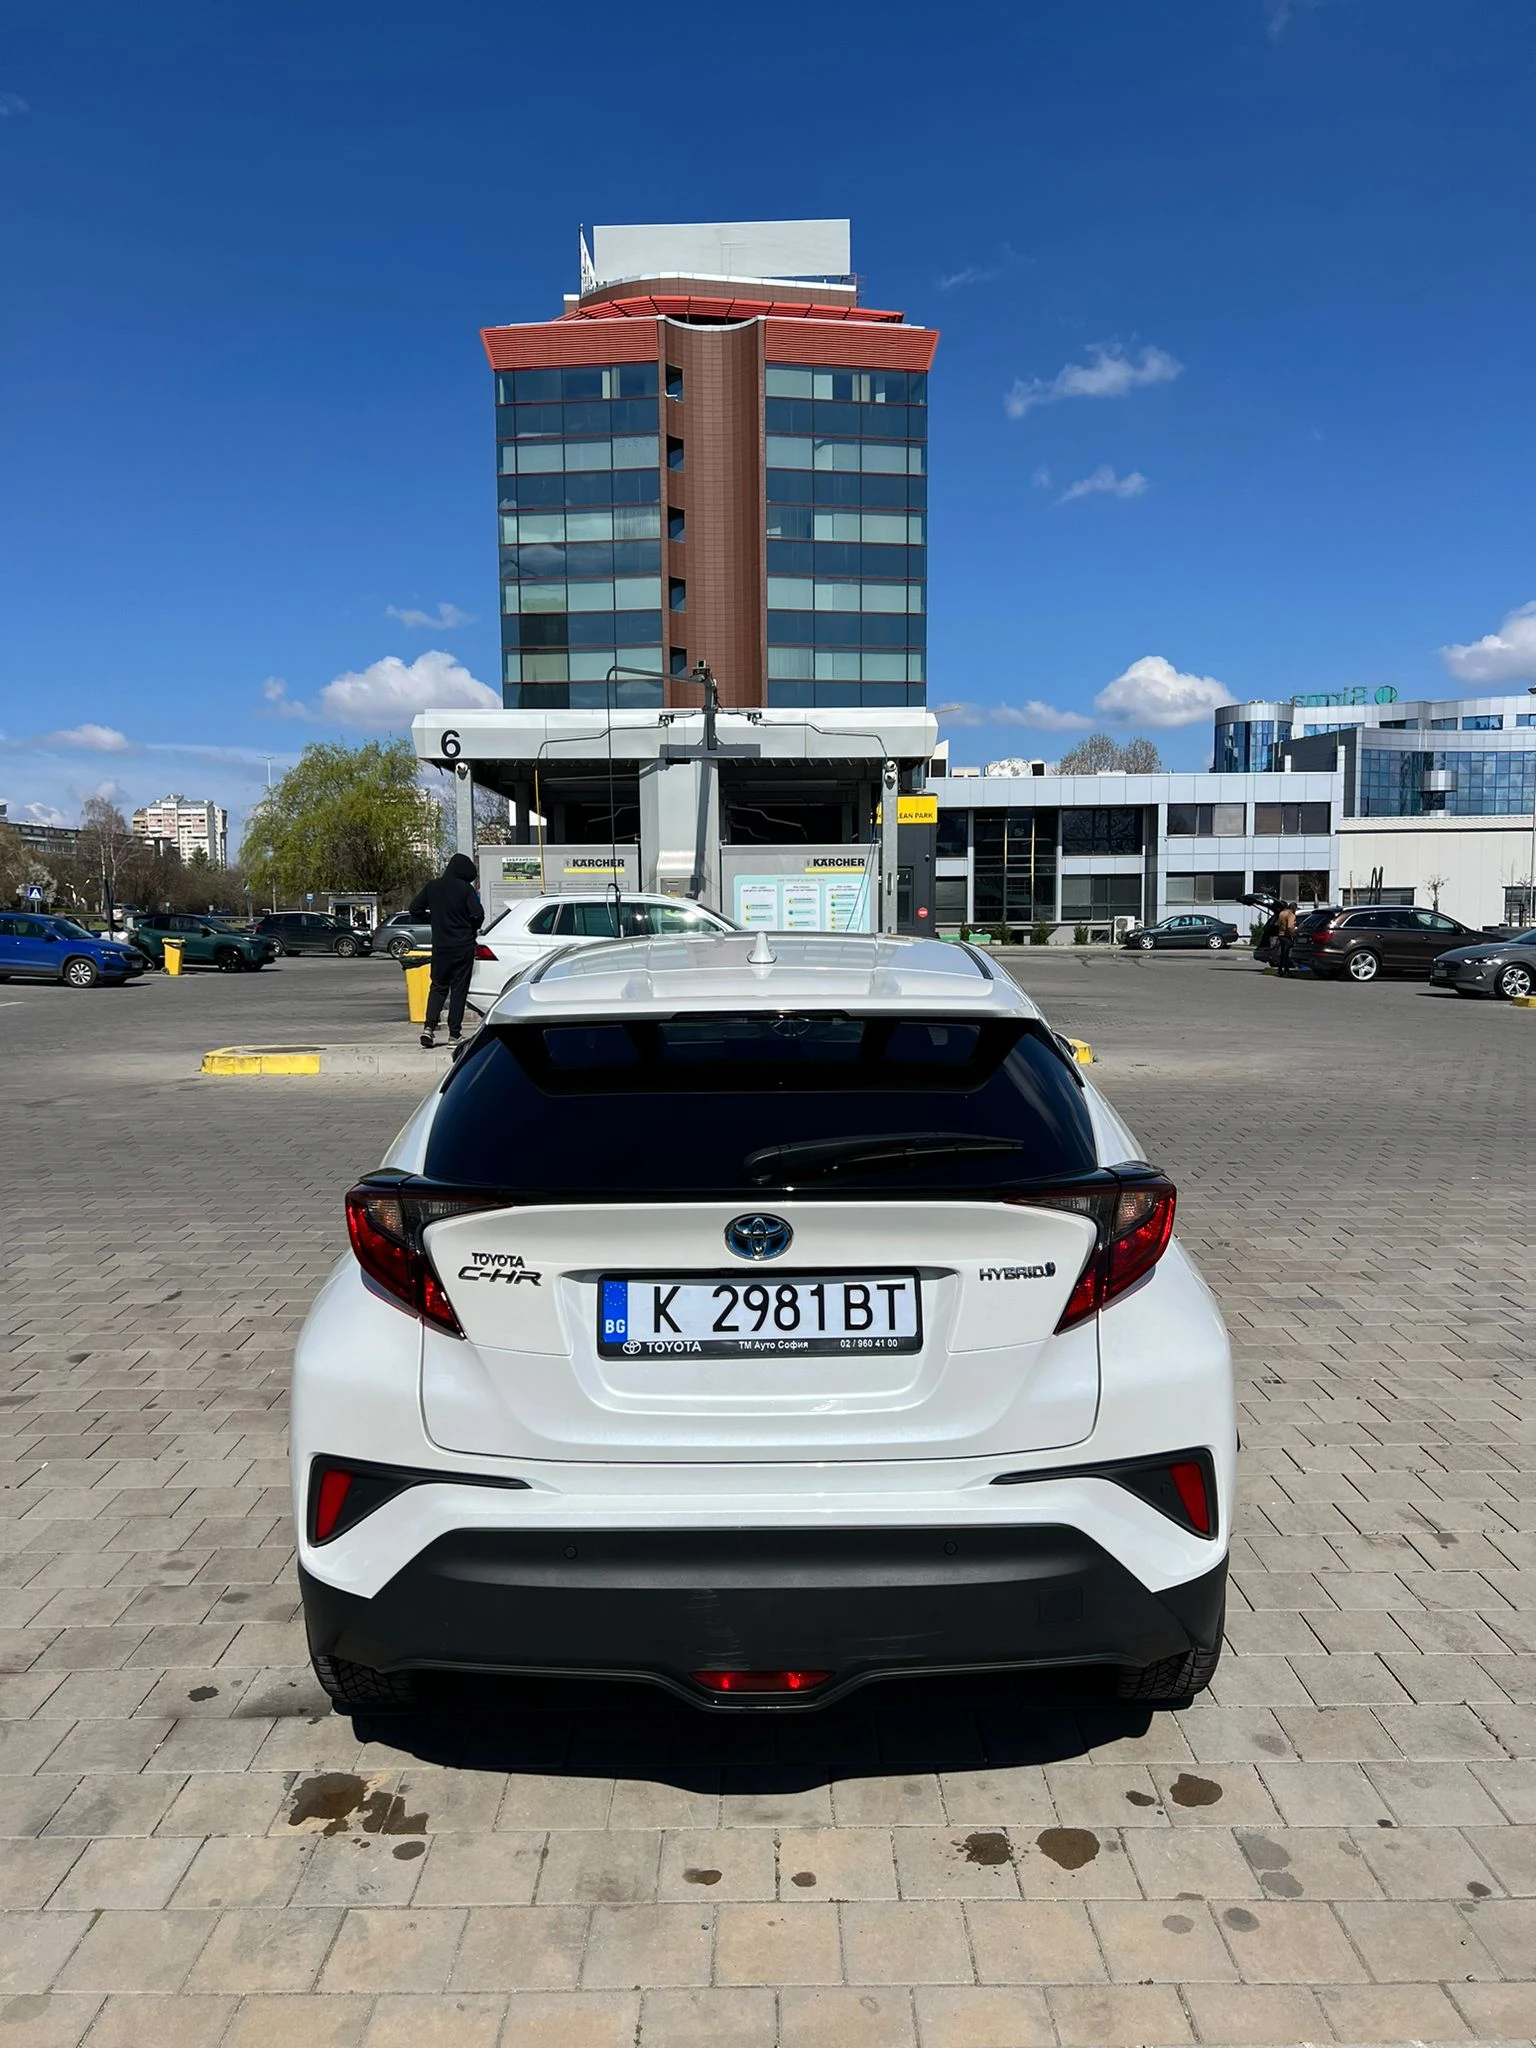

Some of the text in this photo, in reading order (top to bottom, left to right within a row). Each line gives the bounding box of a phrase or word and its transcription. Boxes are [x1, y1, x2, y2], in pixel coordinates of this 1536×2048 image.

[441, 729, 461, 758] 6
[572, 858, 625, 867] KÄRCHER
[813, 858, 865, 867] KÄRCHER
[471, 1252, 525, 1268] TOYOTA
[458, 1266, 542, 1286] C-HR
[979, 1265, 1044, 1281] HYBRID
[653, 1284, 906, 1333] K 2981 BT
[605, 1319, 626, 1334] BG
[646, 1341, 702, 1353] TOYOTA
[754, 1341, 776, 1351] Ауто
[777, 1341, 809, 1350] София
[840, 1339, 850, 1348] 02
[857, 1338, 873, 1348] 960
[875, 1338, 886, 1347] 41
[887, 1338, 898, 1347] 00
